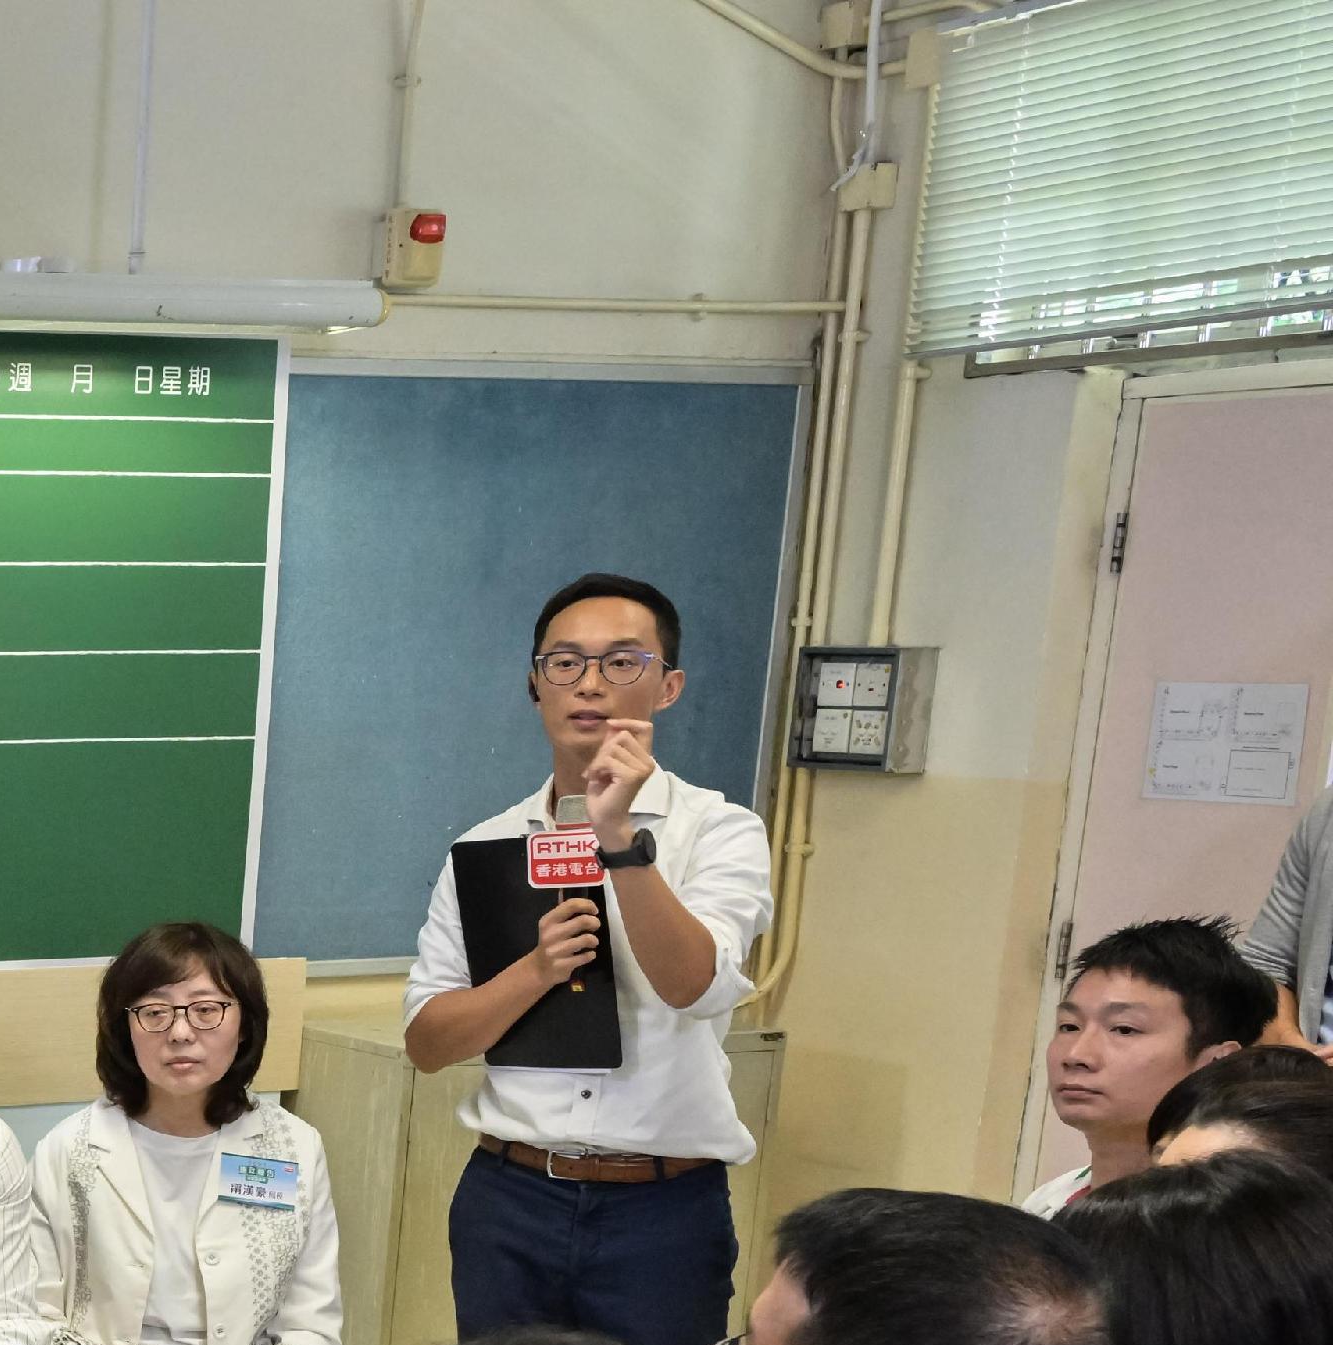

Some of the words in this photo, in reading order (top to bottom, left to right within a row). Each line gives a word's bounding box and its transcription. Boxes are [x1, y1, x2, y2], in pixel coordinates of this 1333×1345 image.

[70, 364, 93, 393] 月
[134, 365, 210, 395] 日星期
[537, 840, 597, 854] RTHK
[536, 862, 600, 878] 香港電台
